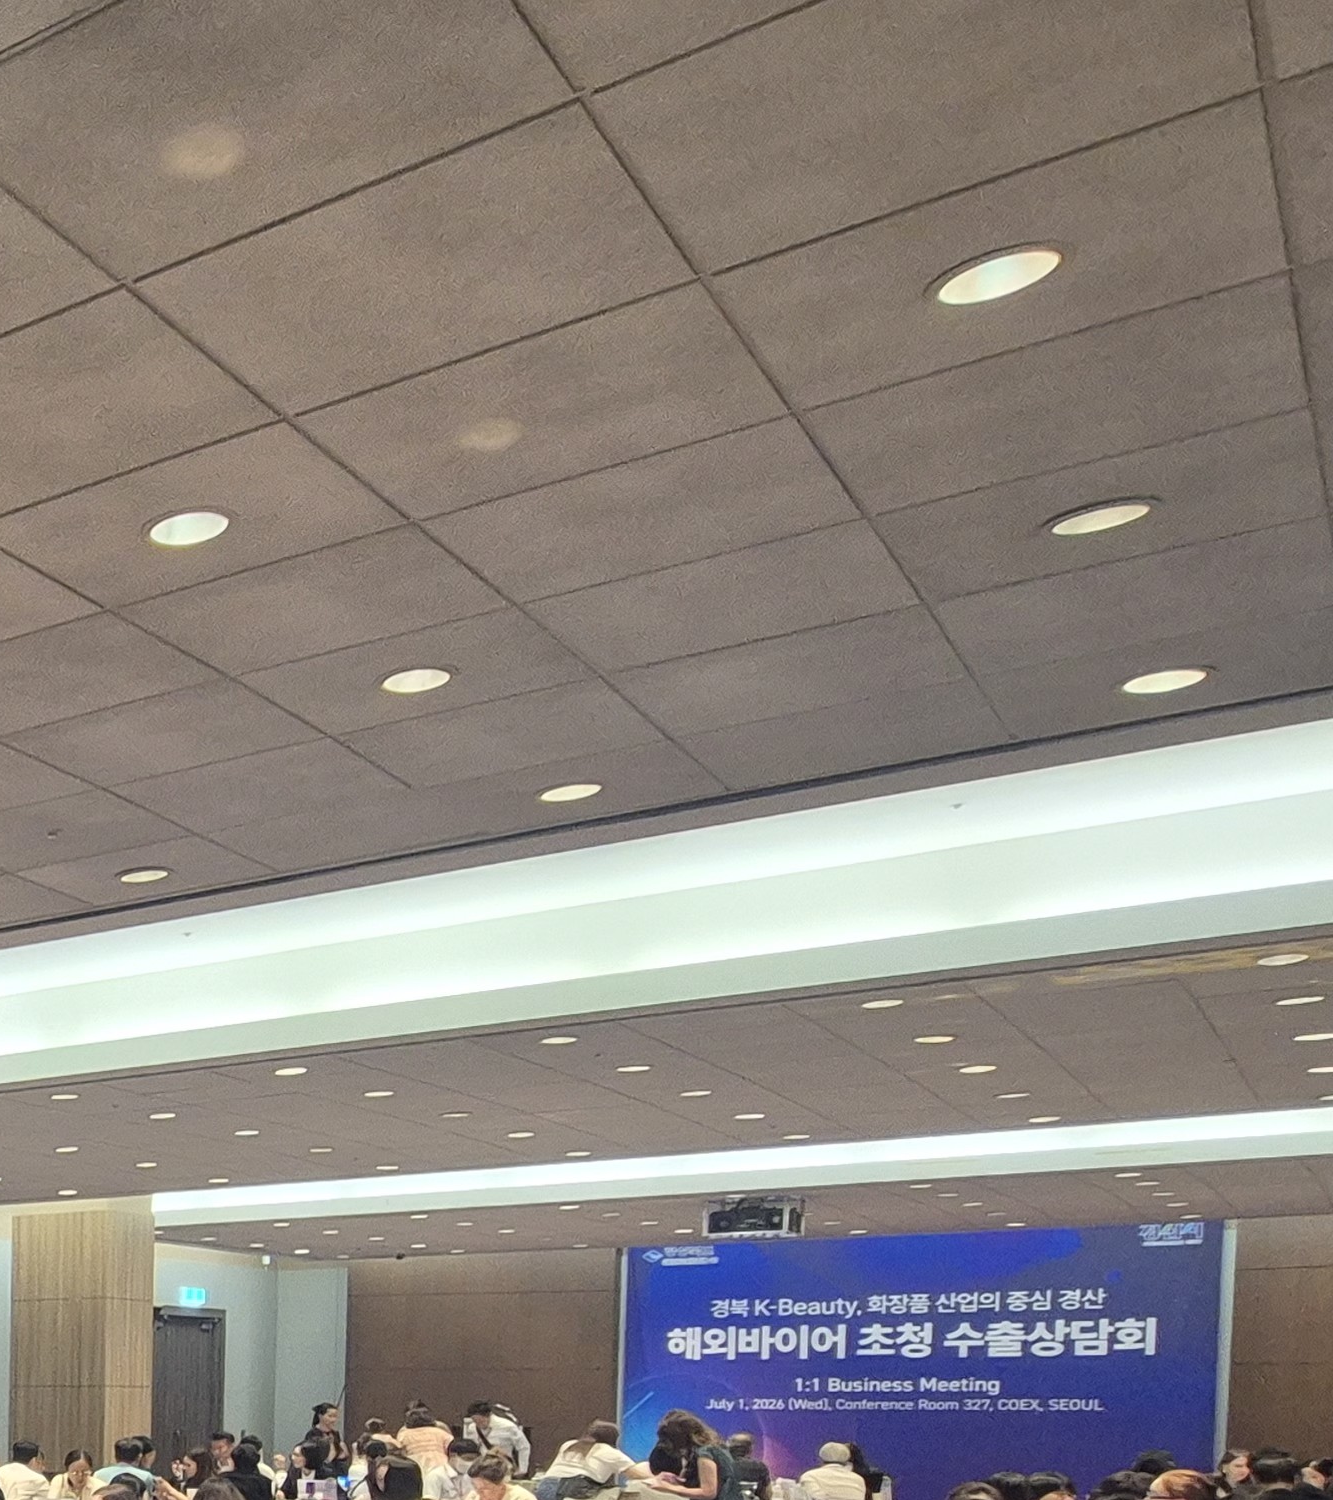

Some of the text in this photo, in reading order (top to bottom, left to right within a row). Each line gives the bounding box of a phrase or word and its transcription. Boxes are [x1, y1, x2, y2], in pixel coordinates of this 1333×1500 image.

[710, 1287, 1108, 1320] 경북 K-Beauty, 화장품 산업의 중심 경산
[666, 1317, 1158, 1361] 해외바이어 초청 수출상담회
[794, 1376, 1001, 1396] 1:1 Business Meeting
[704, 1398, 1106, 1413] July 1, 2026 (Wed), Conference Room 327, COEX, SEOUL
